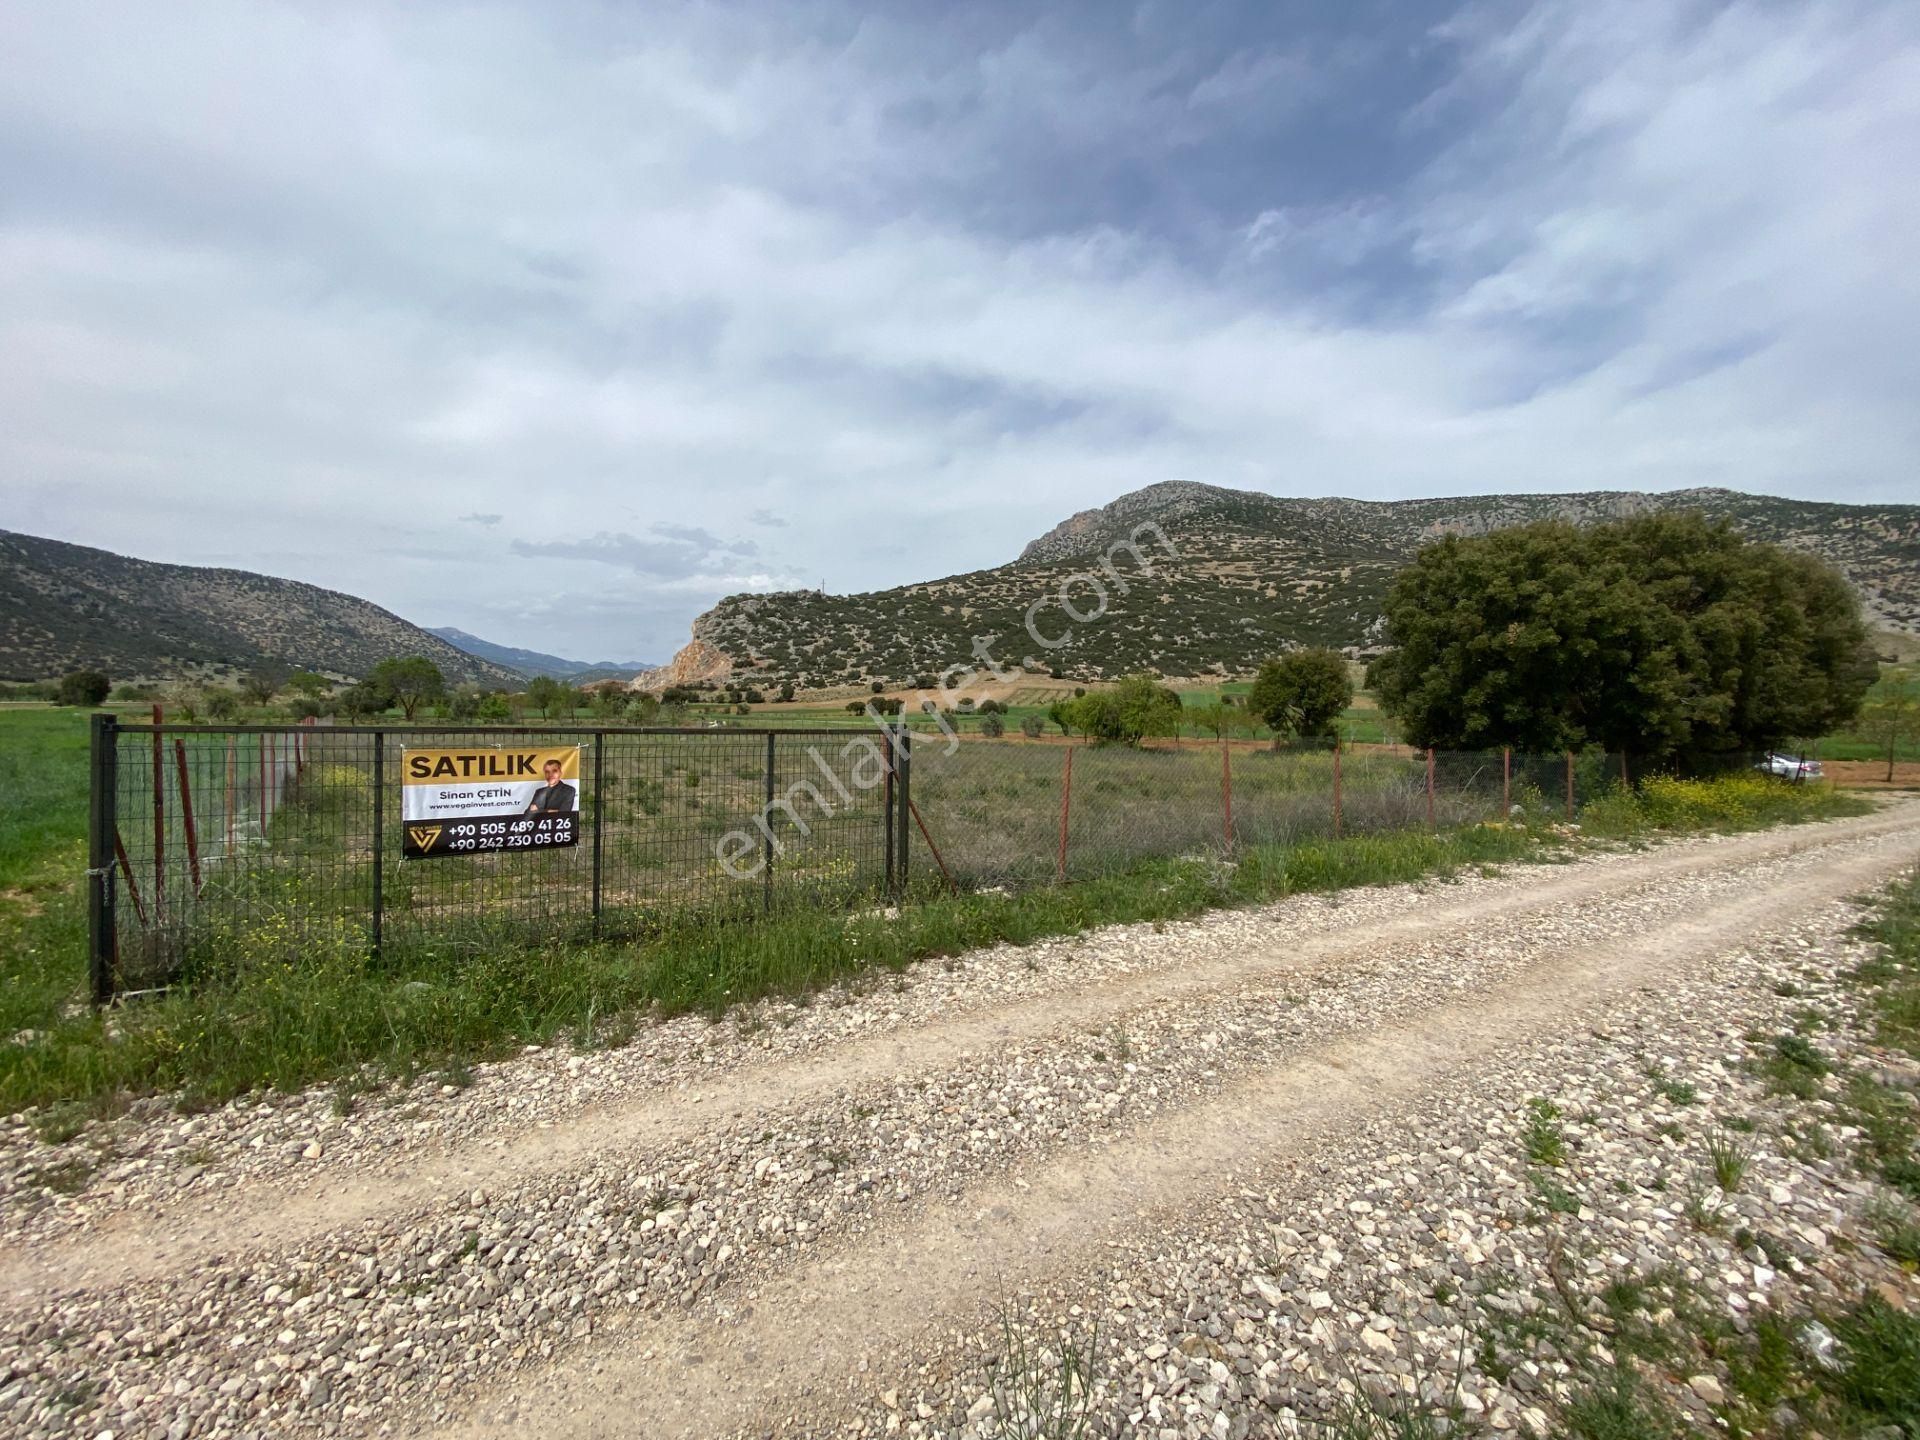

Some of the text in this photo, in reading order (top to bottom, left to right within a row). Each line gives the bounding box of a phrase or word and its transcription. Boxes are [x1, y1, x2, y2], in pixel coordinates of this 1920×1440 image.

[410, 754, 537, 778] SATILIK
[440, 788, 511, 799] Sinan ÇETİN
[430, 801, 520, 809] www.vegainvest.com.tr
[449, 824, 476, 836] +90
[480, 823, 506, 835] 505
[510, 820, 535, 833] 489
[538, 819, 552, 831] 41
[556, 818, 571, 830] 26
[449, 831, 571, 850] +90 242 230 05 05
